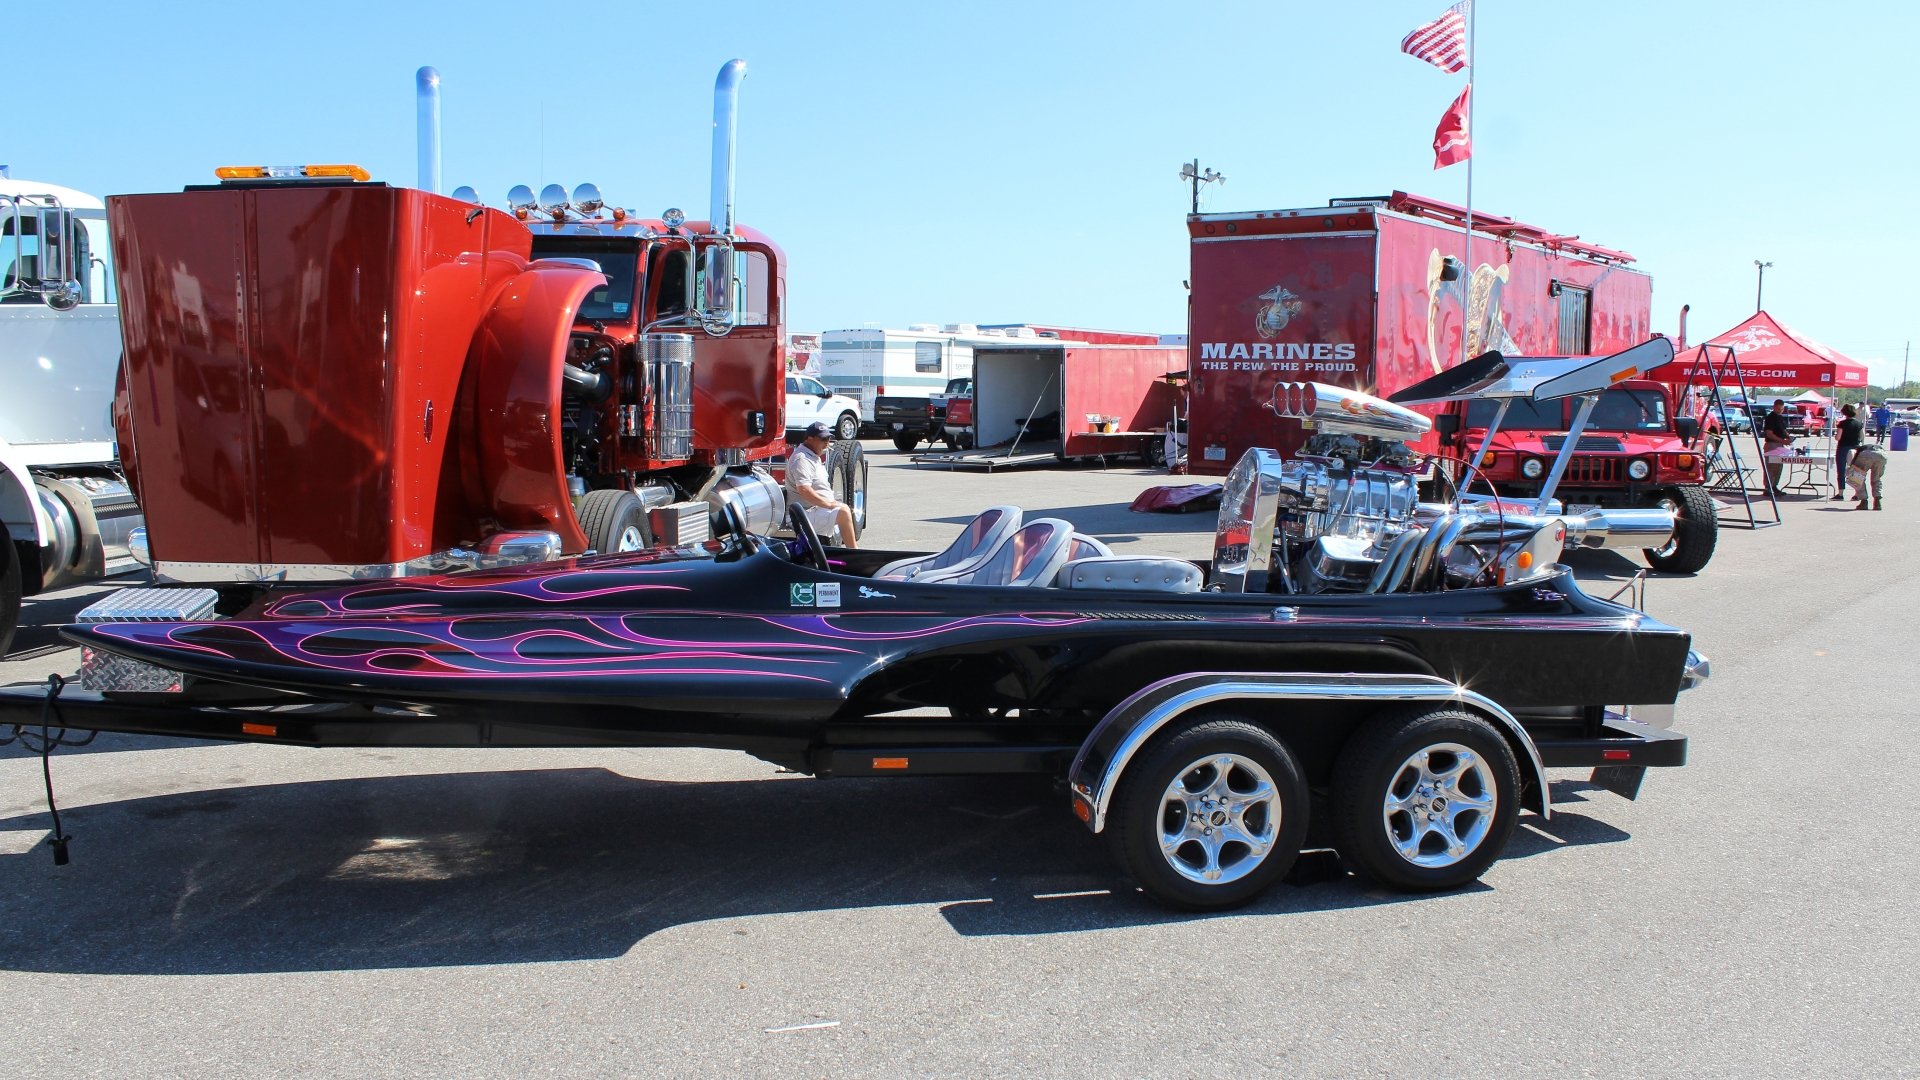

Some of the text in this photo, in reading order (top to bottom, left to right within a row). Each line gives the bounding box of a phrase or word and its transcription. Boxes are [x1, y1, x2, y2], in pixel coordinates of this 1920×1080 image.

[1201, 343, 1355, 359] MARINES
[1201, 361, 1359, 372] THE FEW. THE PROUD.
